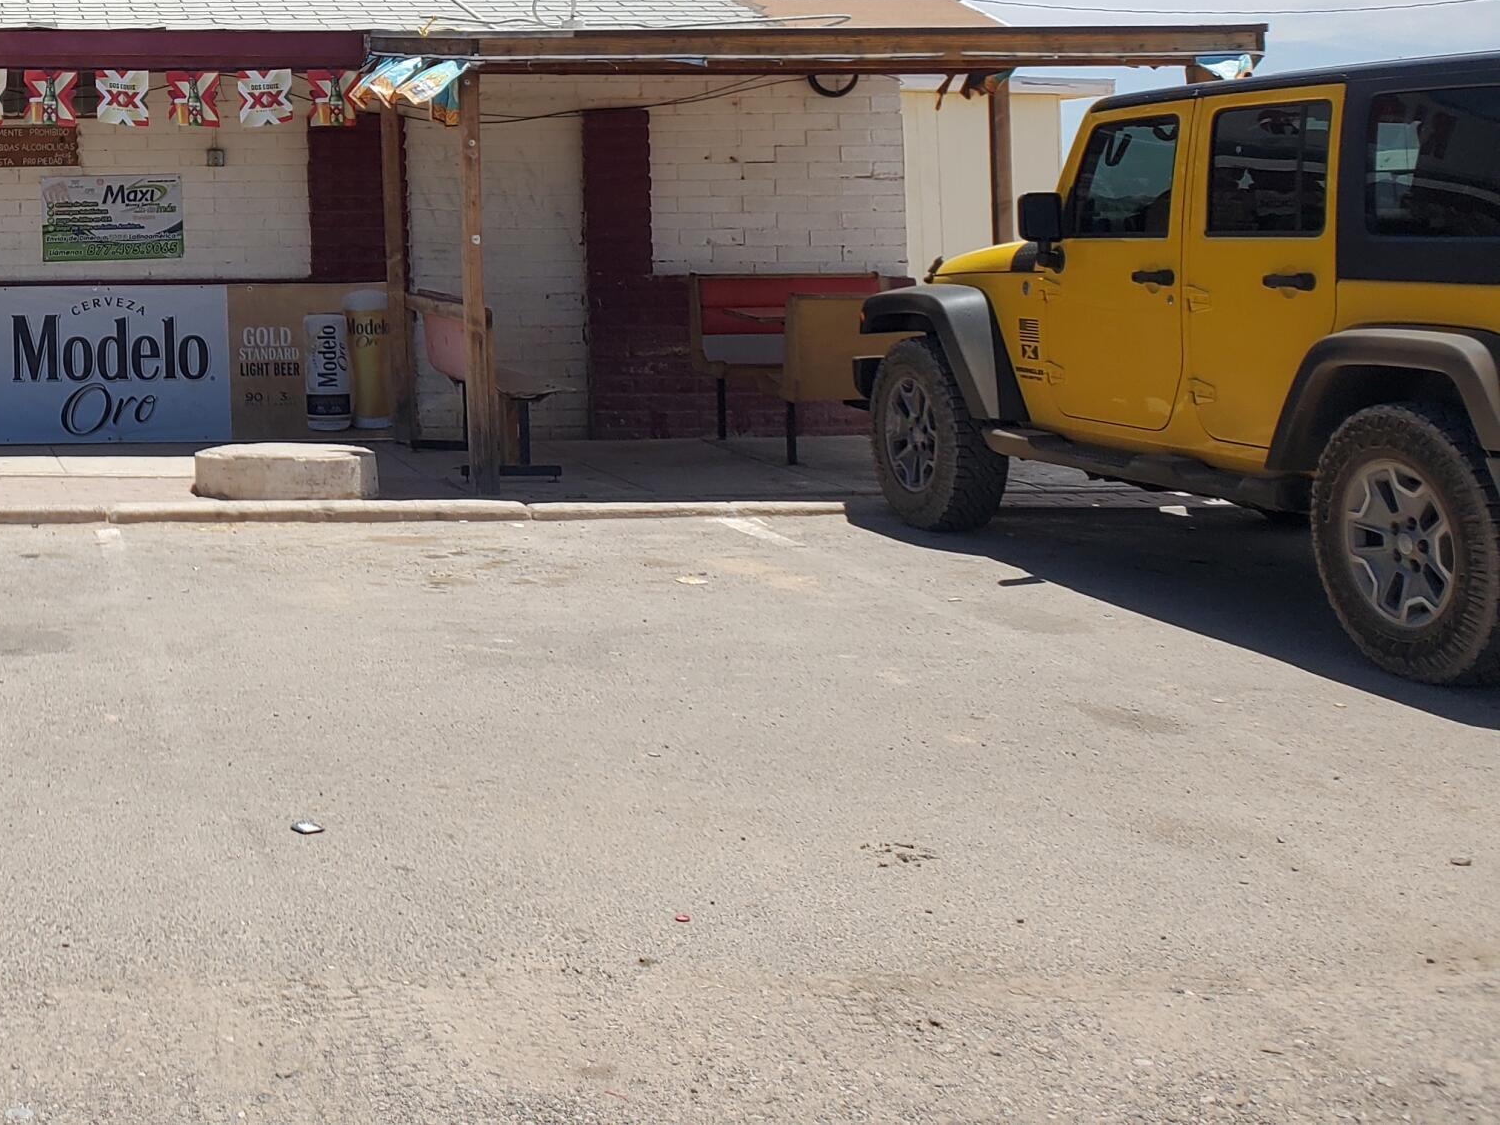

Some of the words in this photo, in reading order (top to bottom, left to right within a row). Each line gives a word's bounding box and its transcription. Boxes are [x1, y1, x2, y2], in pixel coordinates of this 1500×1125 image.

[106, 90, 140, 109] XX
[247, 90, 284, 109] XX
[102, 184, 155, 204] Maxi
[87, 242, 178, 256] 877.495.9065
[71, 297, 146, 316] CERVEZA
[243, 327, 292, 347] GOLD
[11, 314, 210, 382] Modelo
[239, 347, 299, 361] STANDARD
[317, 325, 338, 388] Modelo
[240, 363, 270, 377] LIGHT
[274, 362, 300, 376] BEER
[245, 392, 263, 402] 90
[61, 382, 158, 436] Oro
